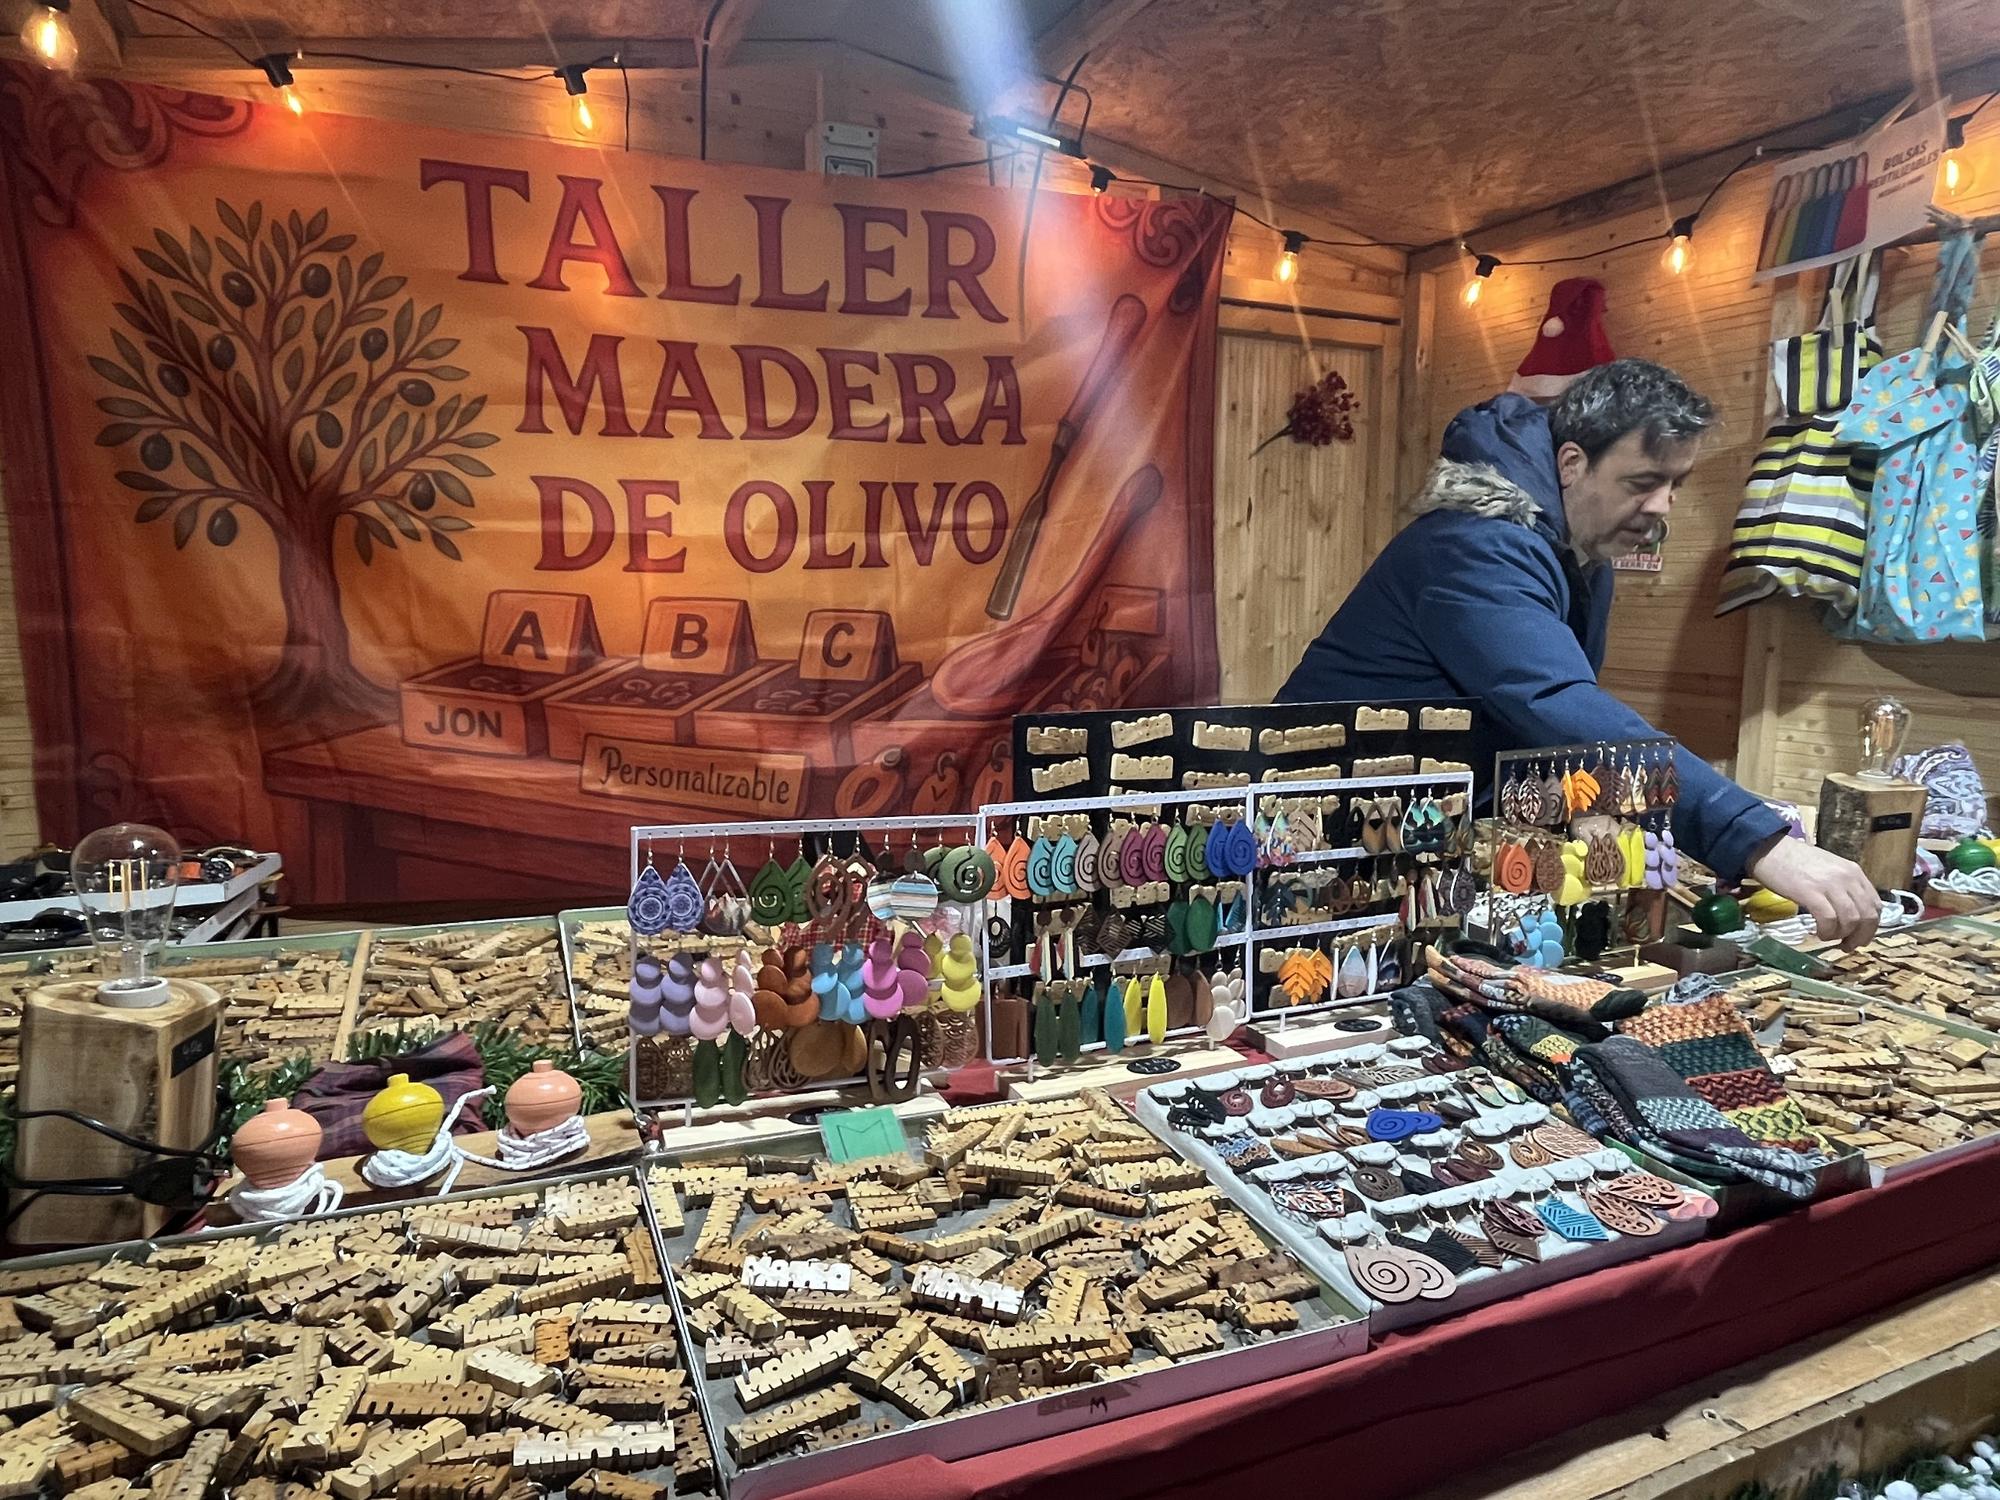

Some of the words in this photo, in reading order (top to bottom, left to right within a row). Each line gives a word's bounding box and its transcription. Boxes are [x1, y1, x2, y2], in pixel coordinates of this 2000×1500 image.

[420, 158, 1009, 323] TALLER
[515, 325, 1027, 447] MADERA
[529, 475, 688, 573] DE
[723, 480, 1009, 574] OLIVO
[501, 611, 548, 661] A
[669, 613, 709, 660] B
[820, 621, 855, 669] C
[424, 704, 503, 739] JON
[598, 745, 791, 805] Personalizable
[836, 1118, 894, 1159] M
